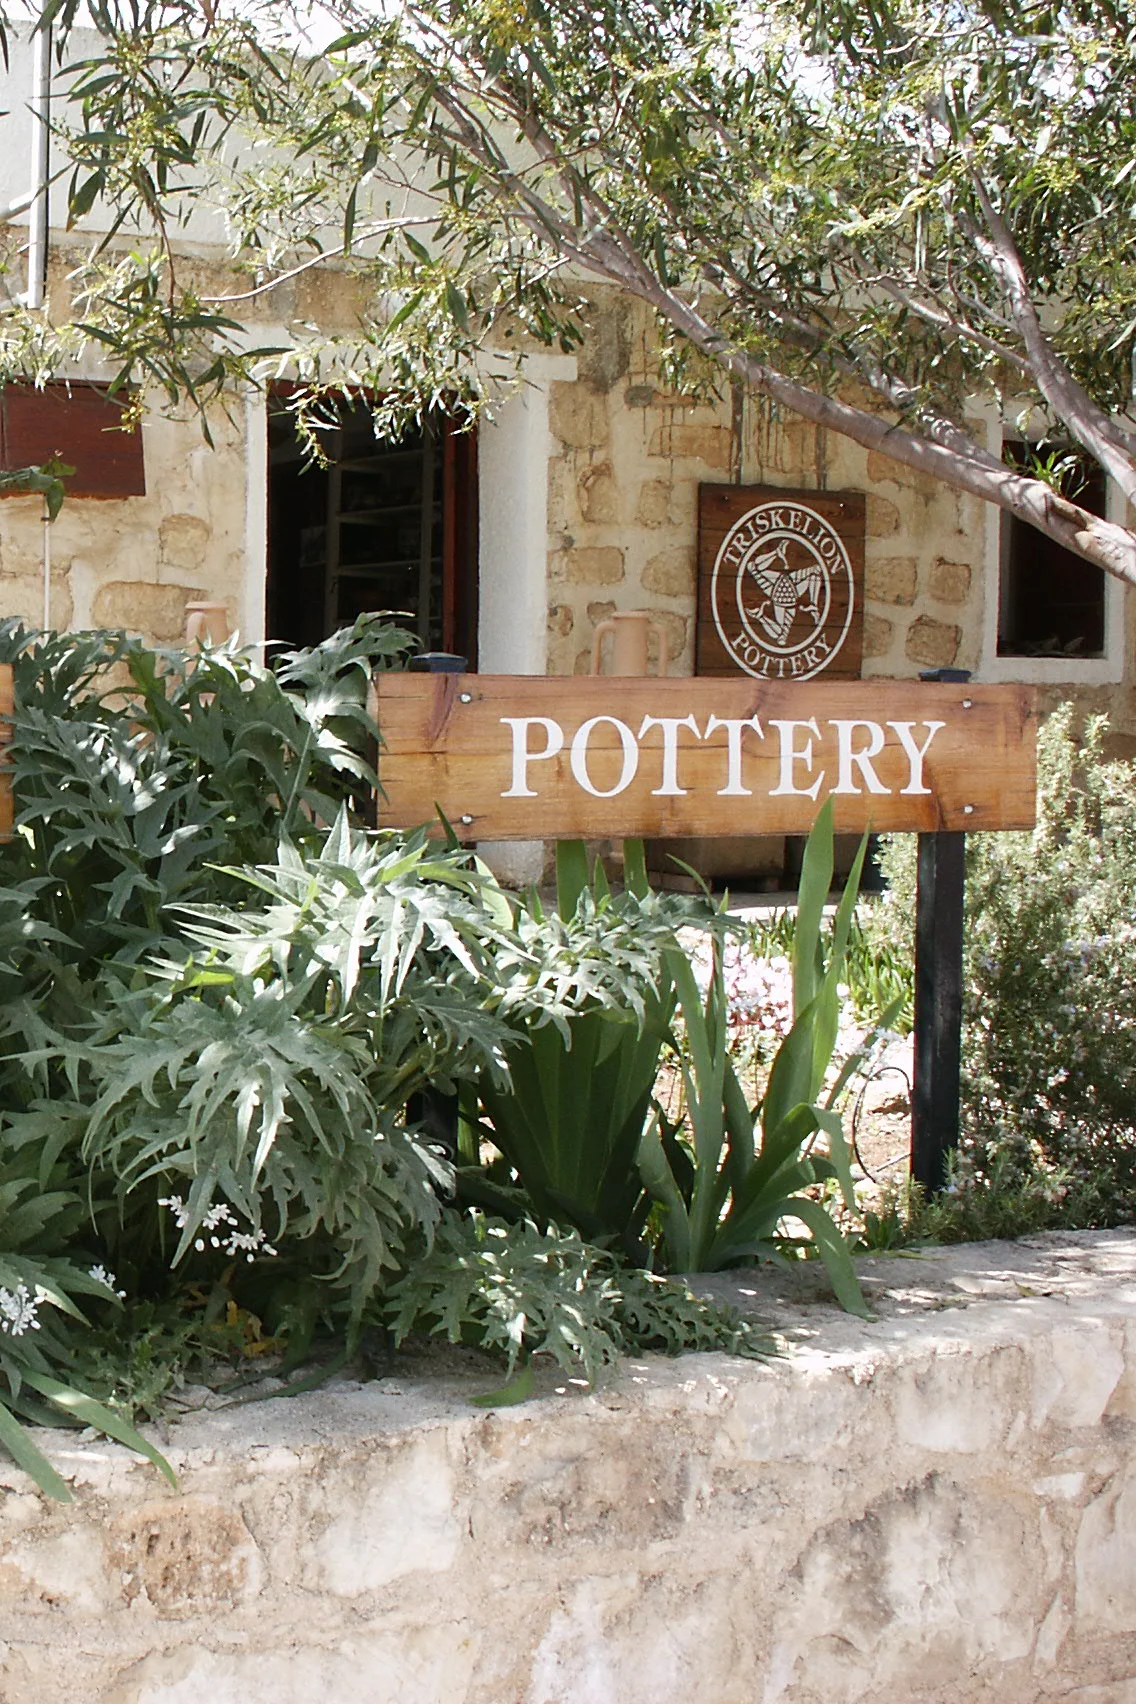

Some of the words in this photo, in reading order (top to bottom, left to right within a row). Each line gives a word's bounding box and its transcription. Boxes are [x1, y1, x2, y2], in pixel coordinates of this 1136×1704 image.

[723, 508, 845, 575] TRISKELION
[731, 630, 832, 678] POTTERY
[499, 713, 946, 800] POTTERY
